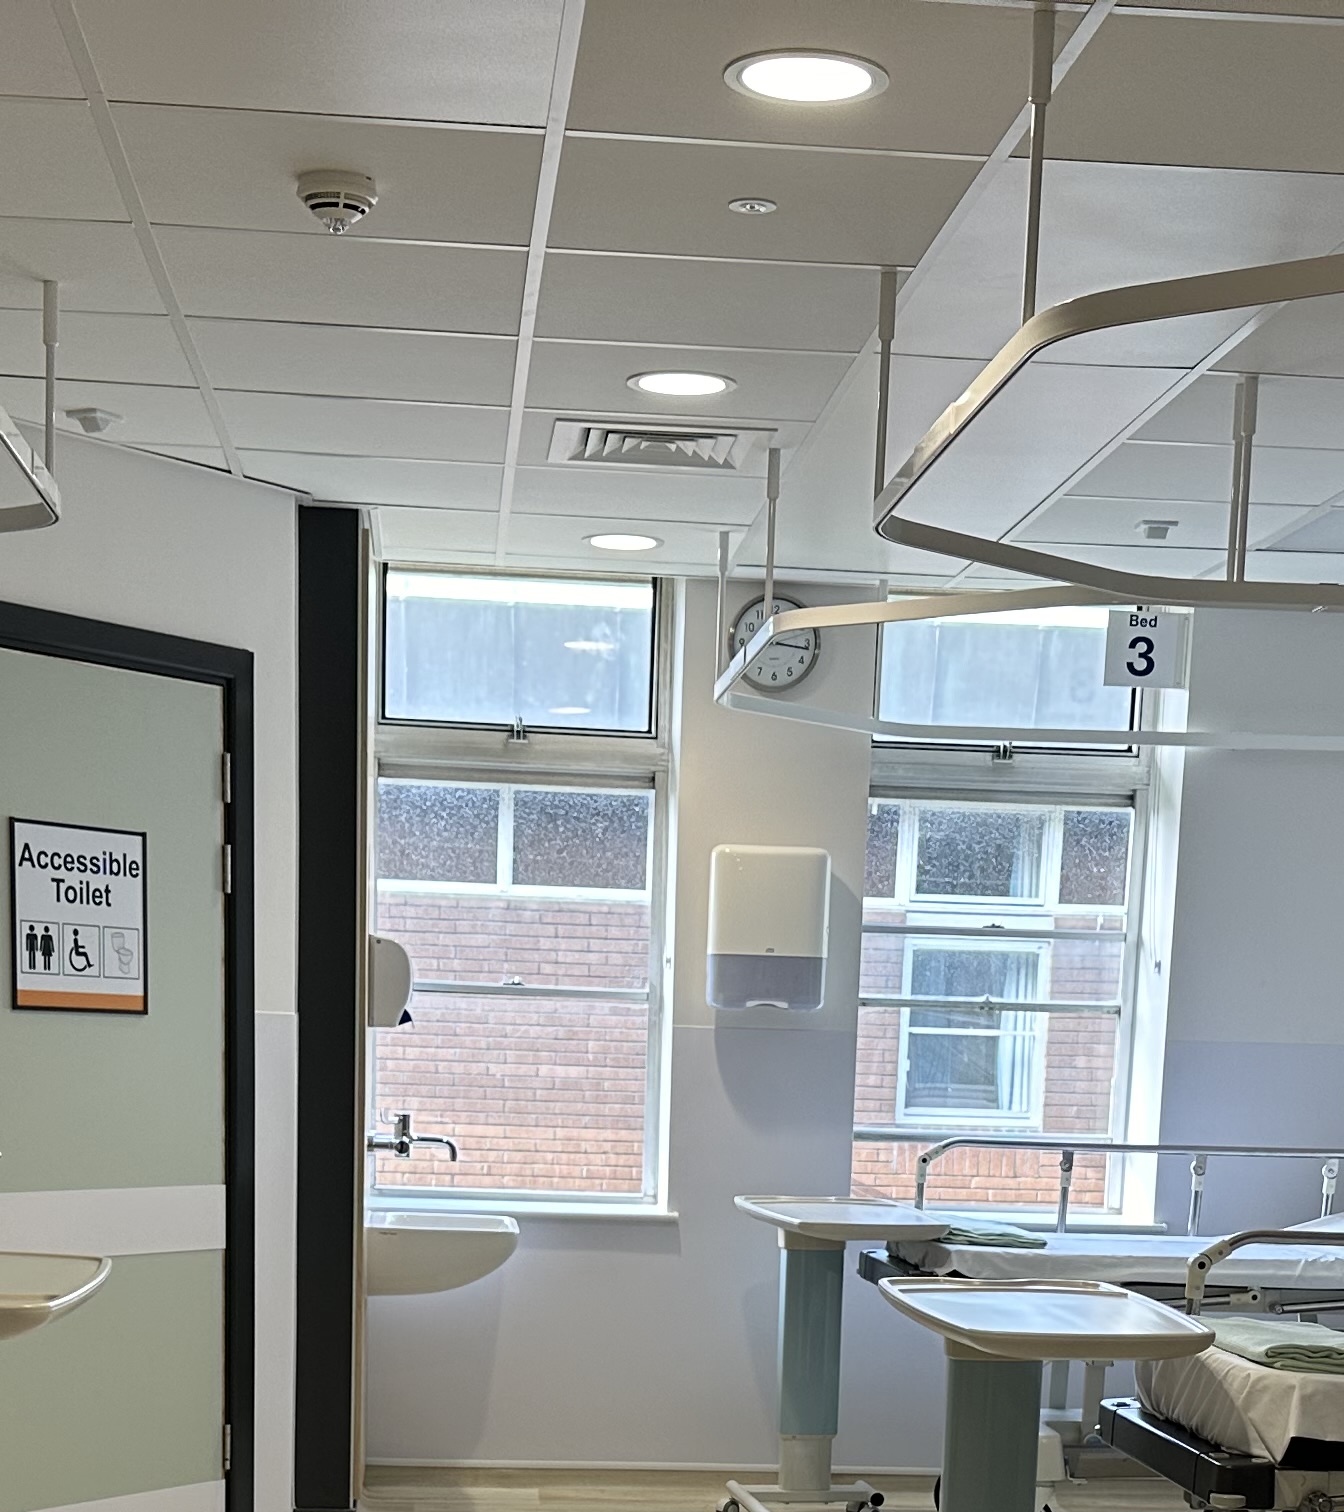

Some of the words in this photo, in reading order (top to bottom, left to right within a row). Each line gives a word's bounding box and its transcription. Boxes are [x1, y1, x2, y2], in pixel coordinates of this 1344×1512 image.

[1129, 614, 1158, 628] Bed
[745, 622, 755, 633] 10
[738, 638, 746, 647] 9
[804, 638, 811, 649] 3
[798, 655, 805, 665] 4
[1126, 636, 1155, 677] 3
[757, 666, 763, 676] 7
[771, 671, 778, 681] 6
[786, 666, 794, 677] 5
[18, 842, 140, 879] Accessible
[51, 877, 113, 908] Toilet
